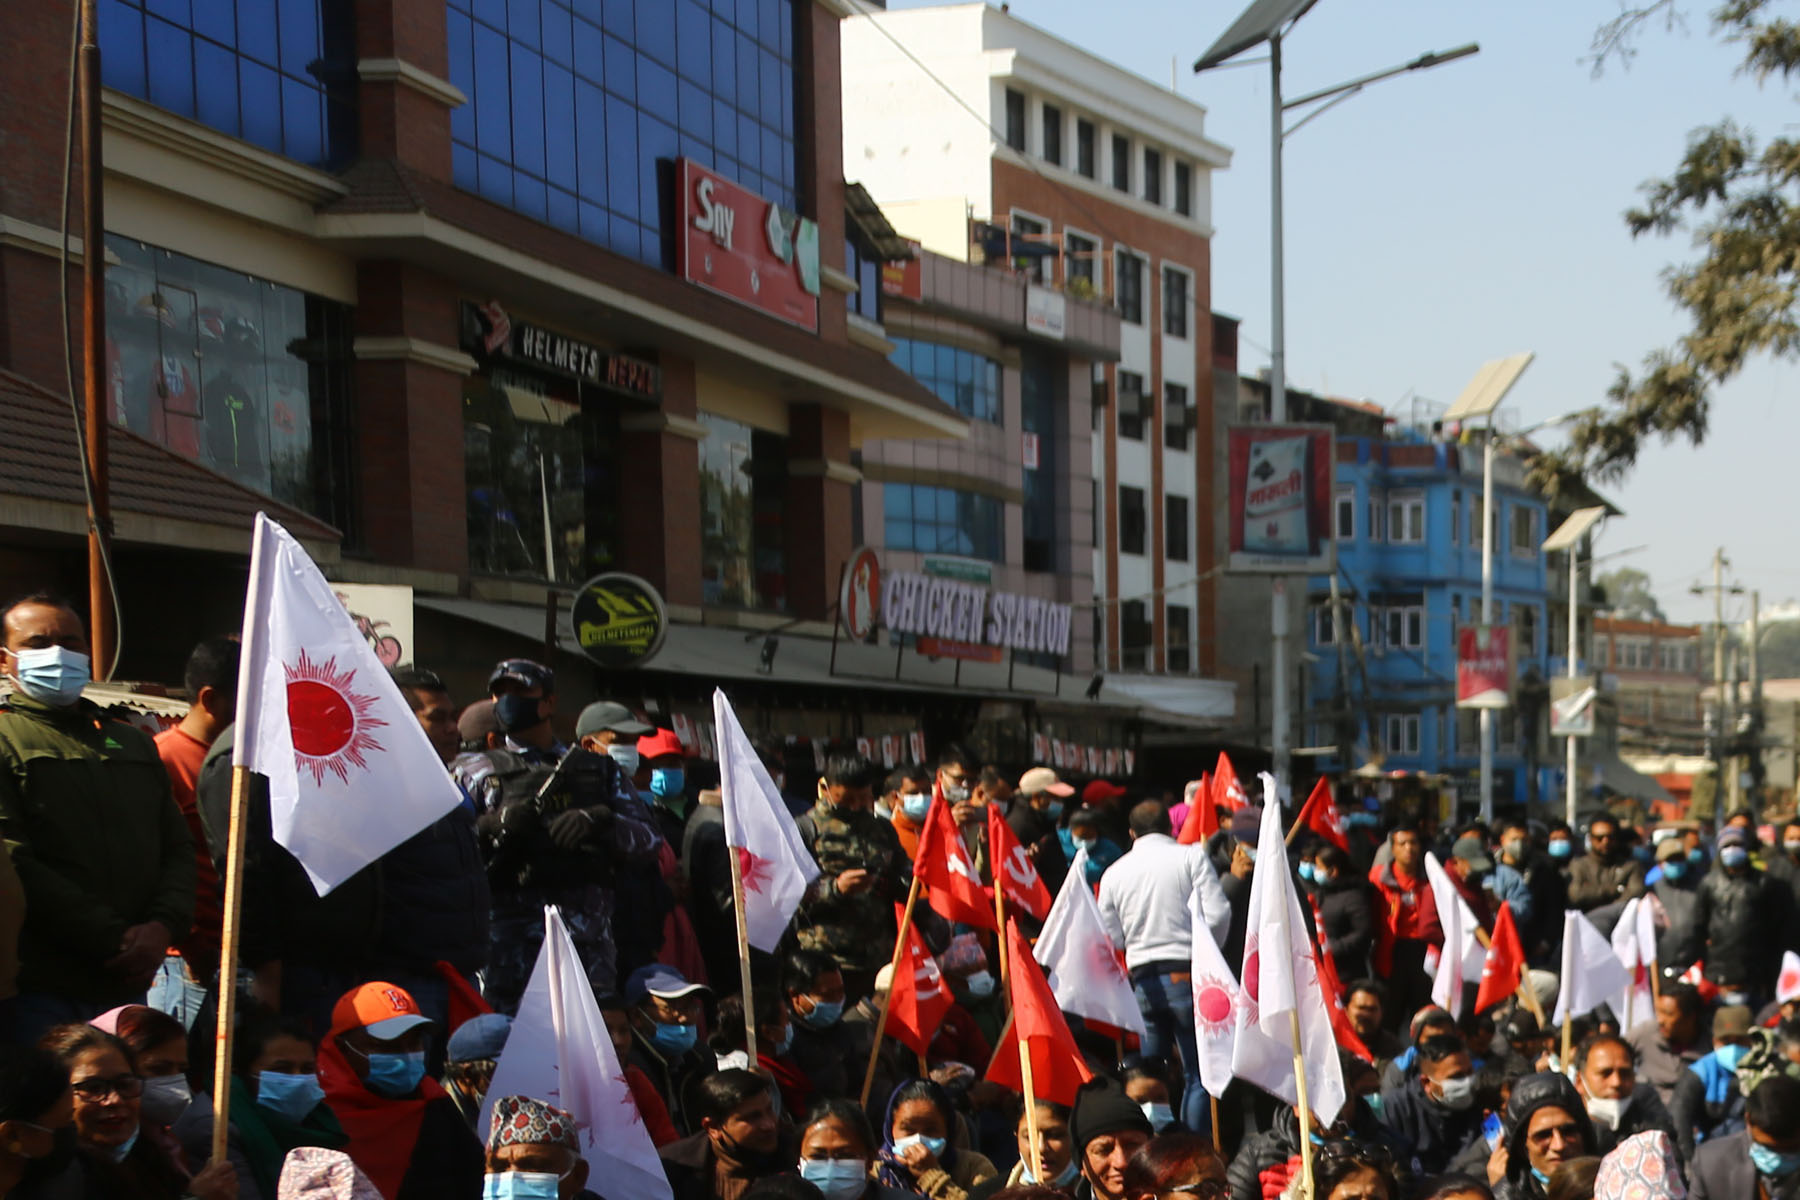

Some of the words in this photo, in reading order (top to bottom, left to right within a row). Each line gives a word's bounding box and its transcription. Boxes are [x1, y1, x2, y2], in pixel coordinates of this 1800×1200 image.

[523, 325, 598, 378] HELMETS
[882, 570, 987, 645] CHICKEN
[987, 591, 1072, 657] STATION
